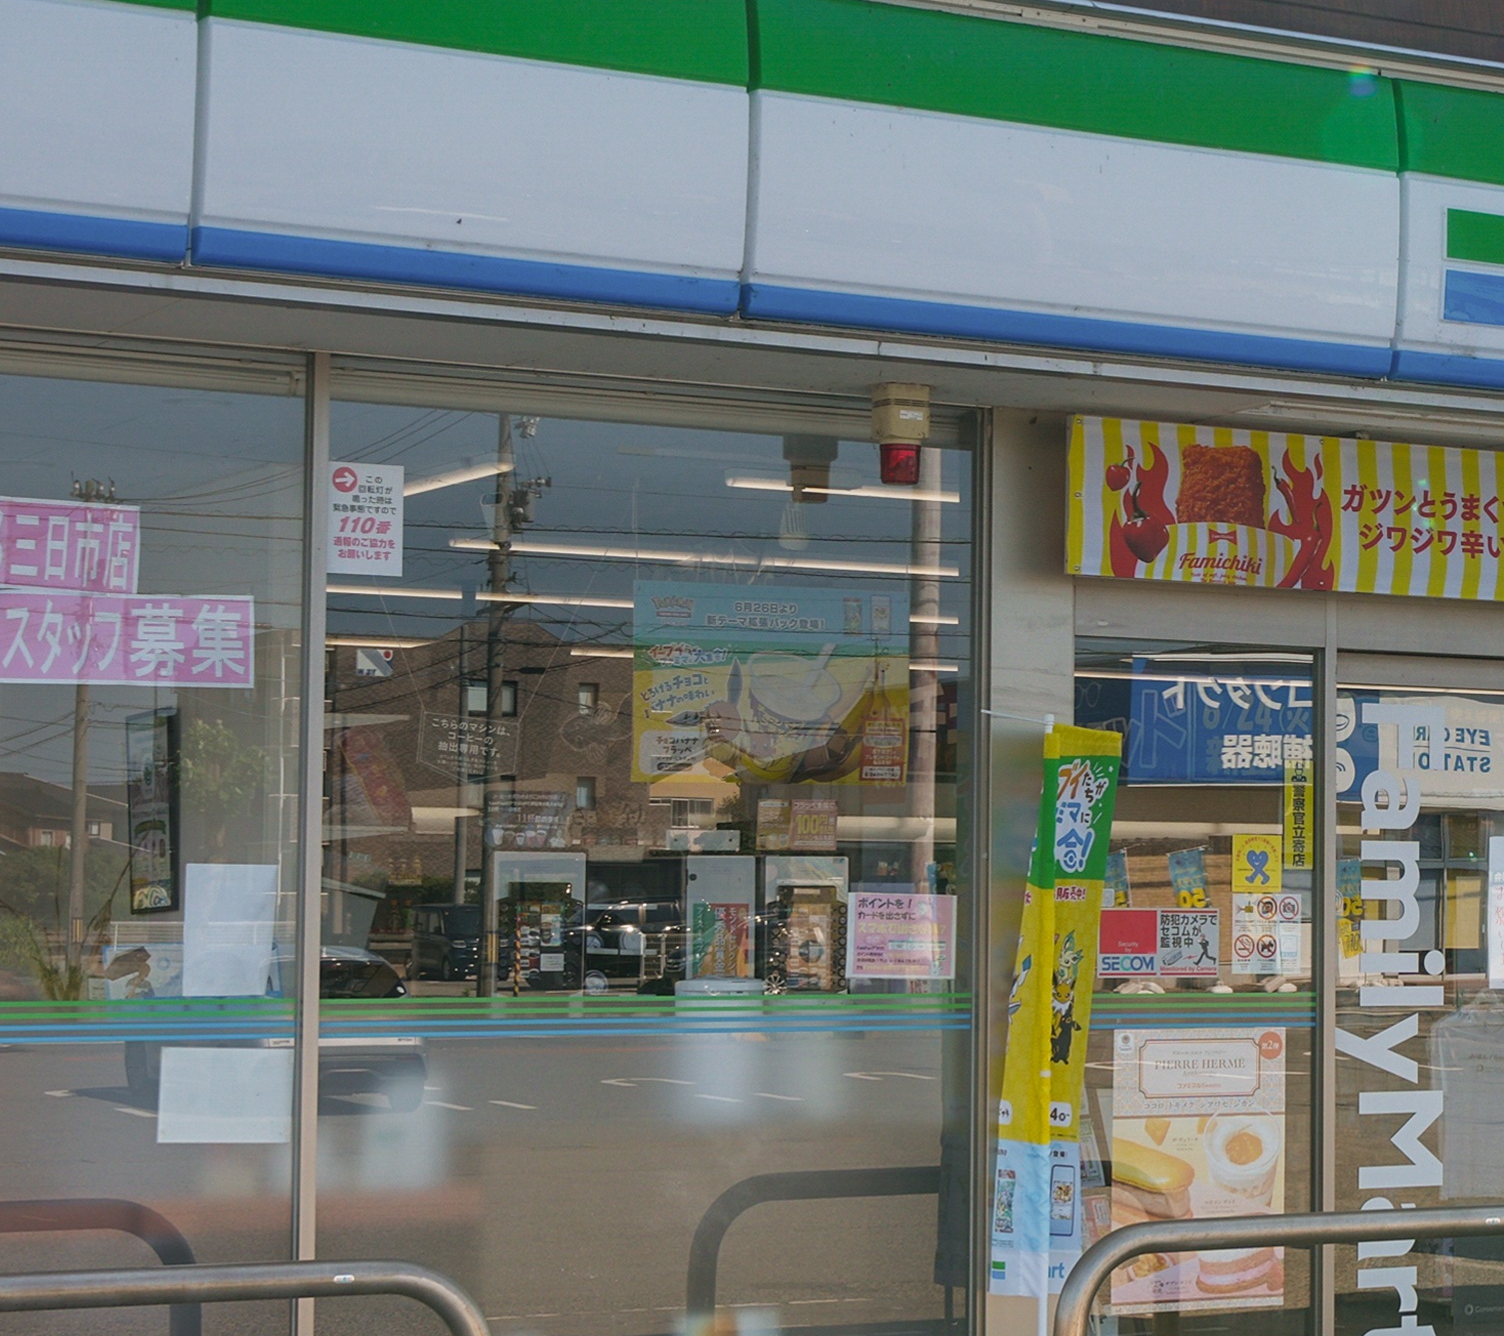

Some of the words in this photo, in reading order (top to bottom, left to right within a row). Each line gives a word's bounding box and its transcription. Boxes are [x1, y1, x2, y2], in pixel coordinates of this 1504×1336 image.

[365, 475, 383, 484] この
[358, 485, 393, 494] 回転灯が
[352, 495, 392, 505] 鳴った時は
[333, 504, 396, 515] 緊急事態ですので
[339, 516, 391, 534] 110番
[333, 536, 396, 549] 通報のご協力を
[338, 549, 391, 561] お願いします
[1179, 552, 1263, 574] Famichiki
[734, 602, 798, 614] 6月26日より
[2, 602, 248, 680] スタッフ募集
[432, 718, 511, 736] こちらのマシンは、
[448, 731, 493, 745] コーヒーの
[438, 741, 501, 757] 抽出専用です。
[1160, 914, 1218, 927] 防犯カメラで
[1160, 925, 1201, 938] セコムが
[1160, 937, 1194, 949] 監視中
[1102, 956, 1155, 971] SECOM
[1160, 965, 1188, 973] Monitored
[1197, 965, 1217, 973] Camera
[1155, 1058, 1199, 1071] PIERRE
